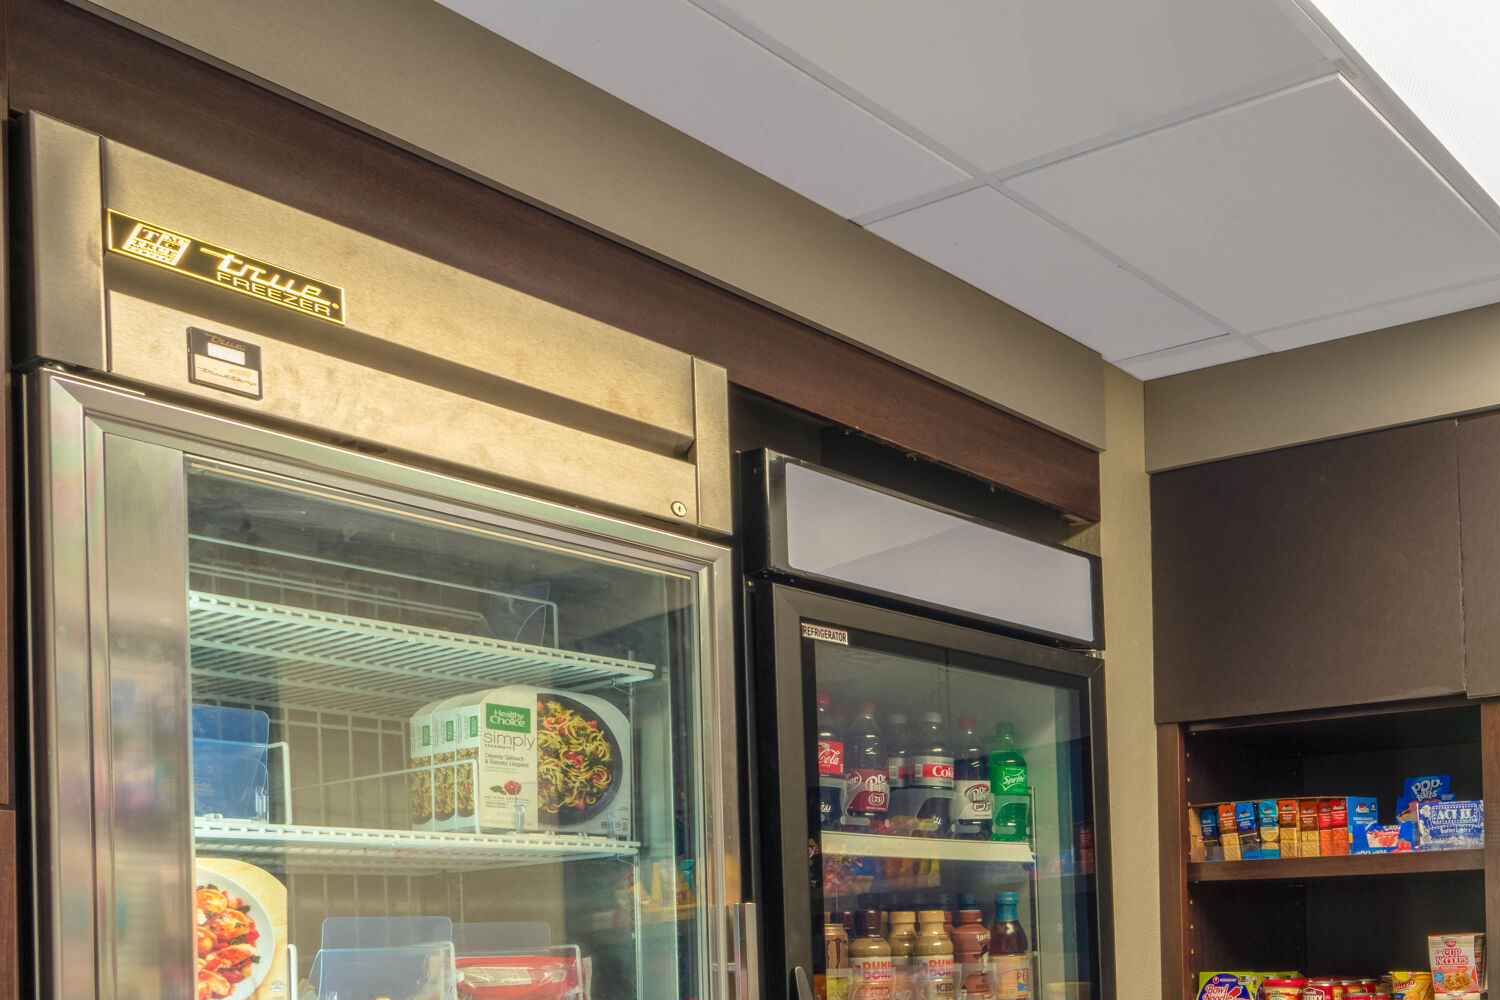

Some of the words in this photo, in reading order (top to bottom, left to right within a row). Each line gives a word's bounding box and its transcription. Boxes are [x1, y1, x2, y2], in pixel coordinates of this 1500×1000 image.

[217, 271, 331, 316] FREEZER
[802, 625, 847, 642] REFRIGERATOR
[494, 709, 524, 720] Healthy
[490, 715, 526, 728] Choice
[483, 731, 535, 751] simply
[1002, 775, 1026, 787] Sprite
[1437, 809, 1457, 820] ACT
[1460, 809, 1473, 819] II
[1442, 948, 1462, 957] CUP
[1435, 956, 1469, 966] NOODLES
[1205, 984, 1229, 994] Bowl
